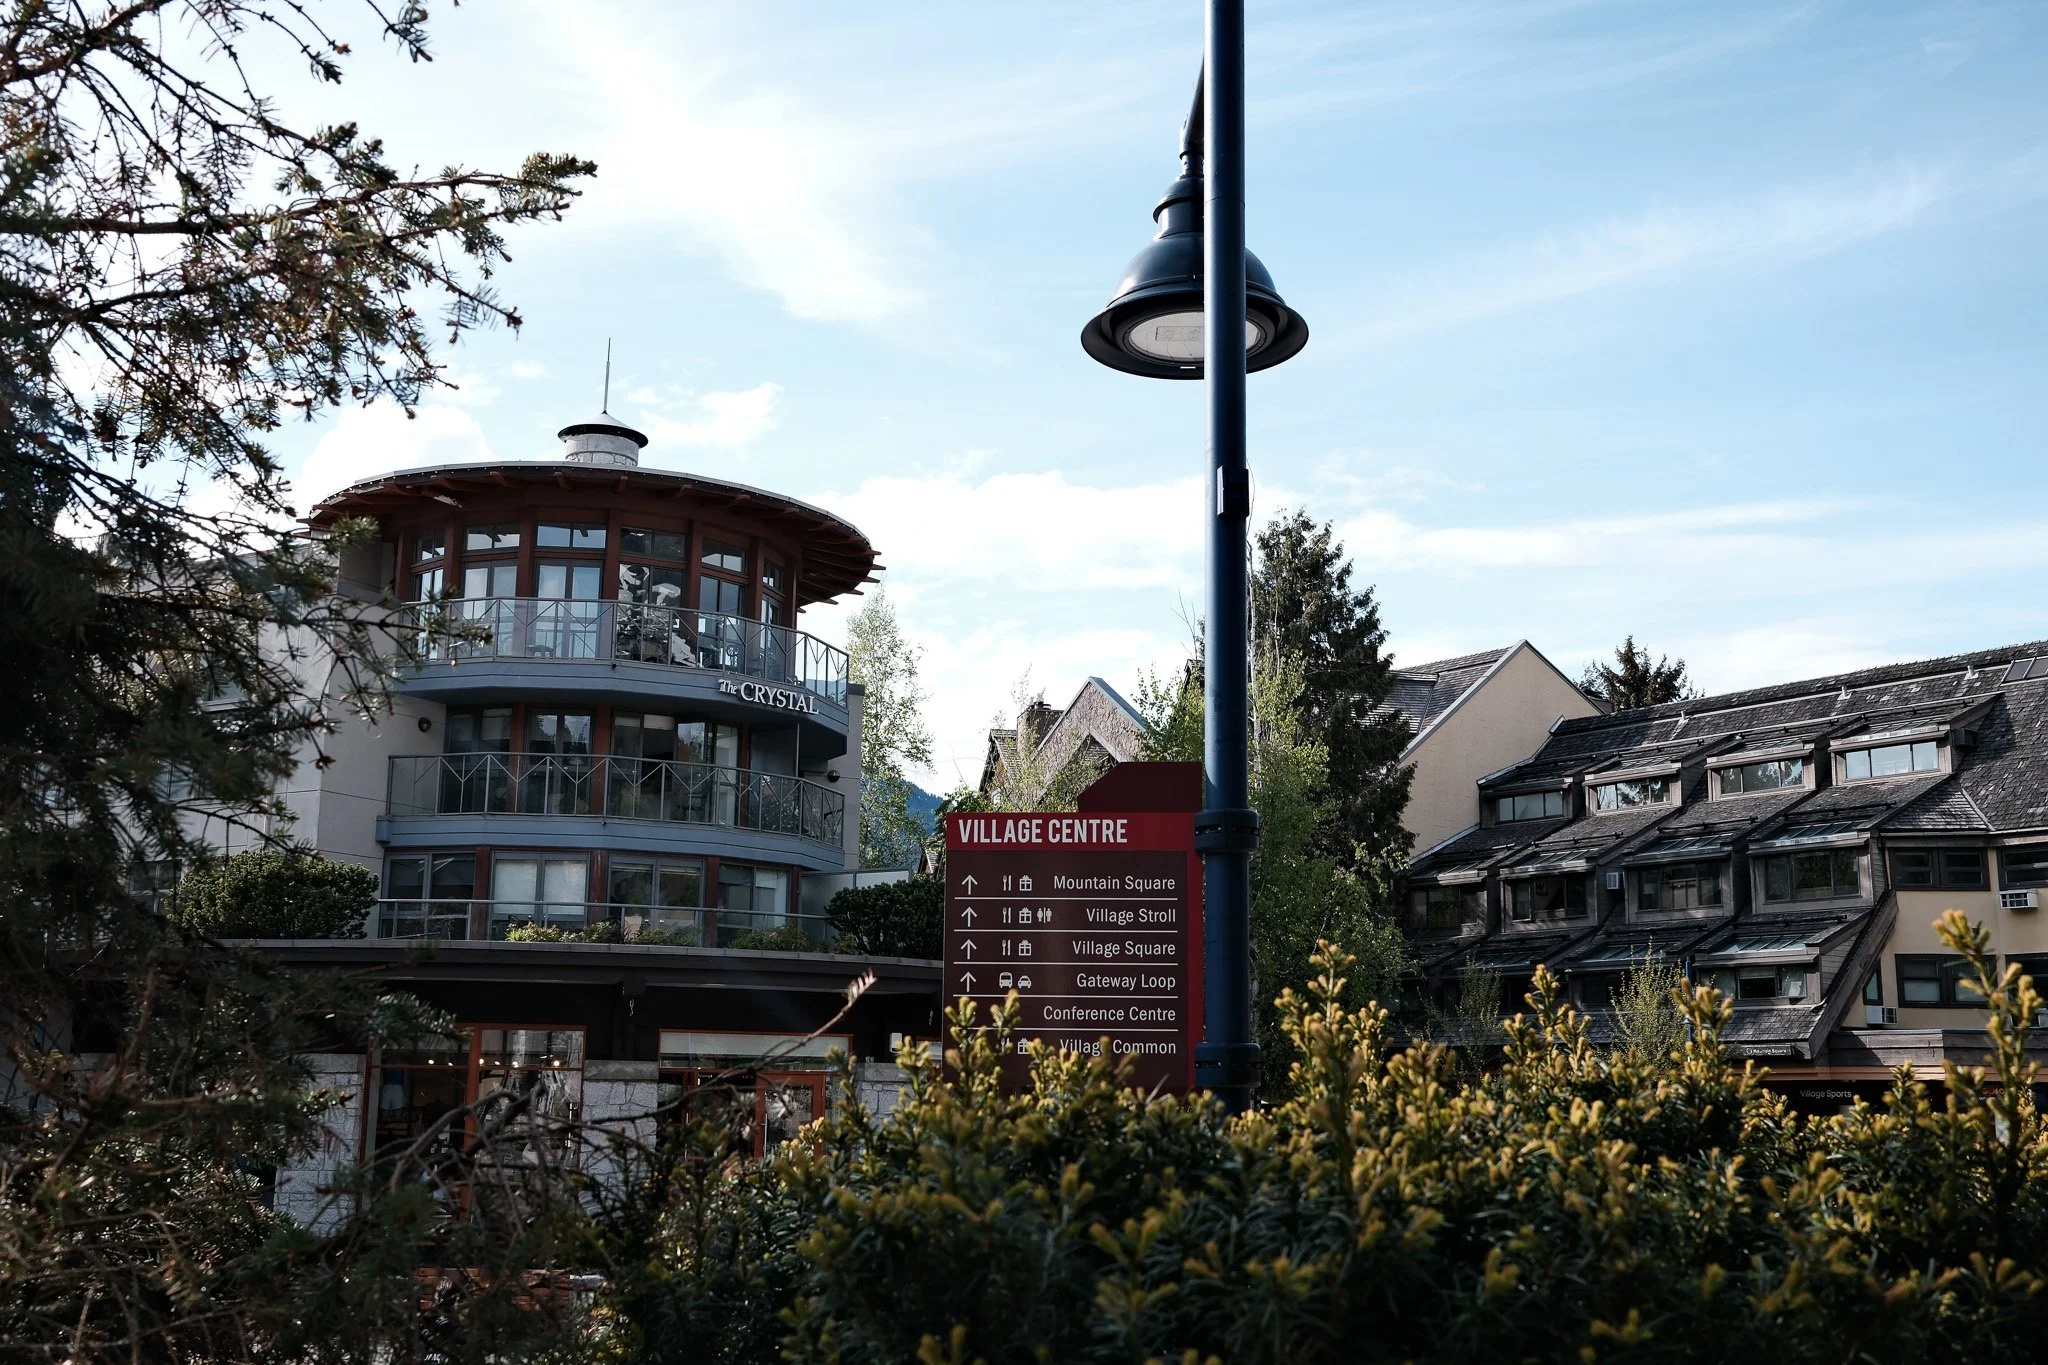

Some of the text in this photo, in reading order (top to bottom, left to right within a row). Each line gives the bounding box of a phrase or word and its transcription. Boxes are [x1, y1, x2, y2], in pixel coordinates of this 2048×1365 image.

[718, 679, 819, 715] The CRYSTAL
[959, 819, 1128, 844] VILLAGE CENTRE
[1054, 875, 1176, 893] Mountain Square
[1086, 908, 1176, 926] Village Stroll
[1073, 940, 1176, 958] Village Square
[1076, 973, 1176, 991] Gateway Loop
[1043, 1005, 1176, 1021] Conference Centre
[1060, 1038, 1176, 1056] Villag Common
[1799, 1089, 1852, 1099] Village Sports
